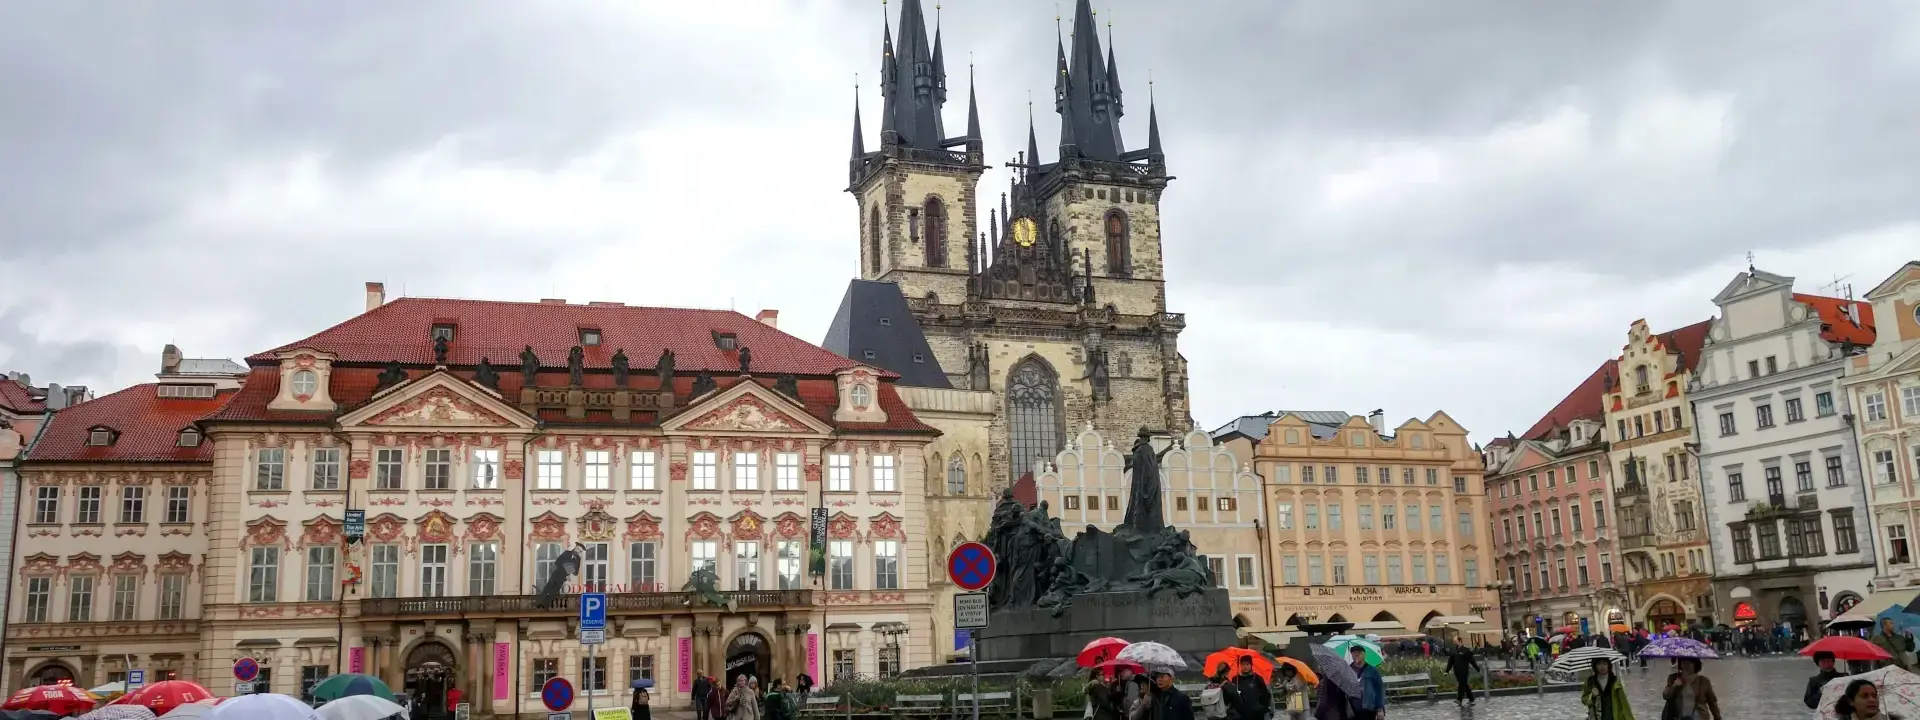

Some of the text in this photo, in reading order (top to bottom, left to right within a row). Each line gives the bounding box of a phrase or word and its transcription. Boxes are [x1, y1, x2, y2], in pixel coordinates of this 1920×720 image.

[1352, 587, 1378, 595] MUCHA
[1394, 586, 1422, 594] WARHOL
[586, 597, 601, 618] P
[352, 649, 360, 673] ITION
[497, 644, 506, 677] VÝSTAVA
